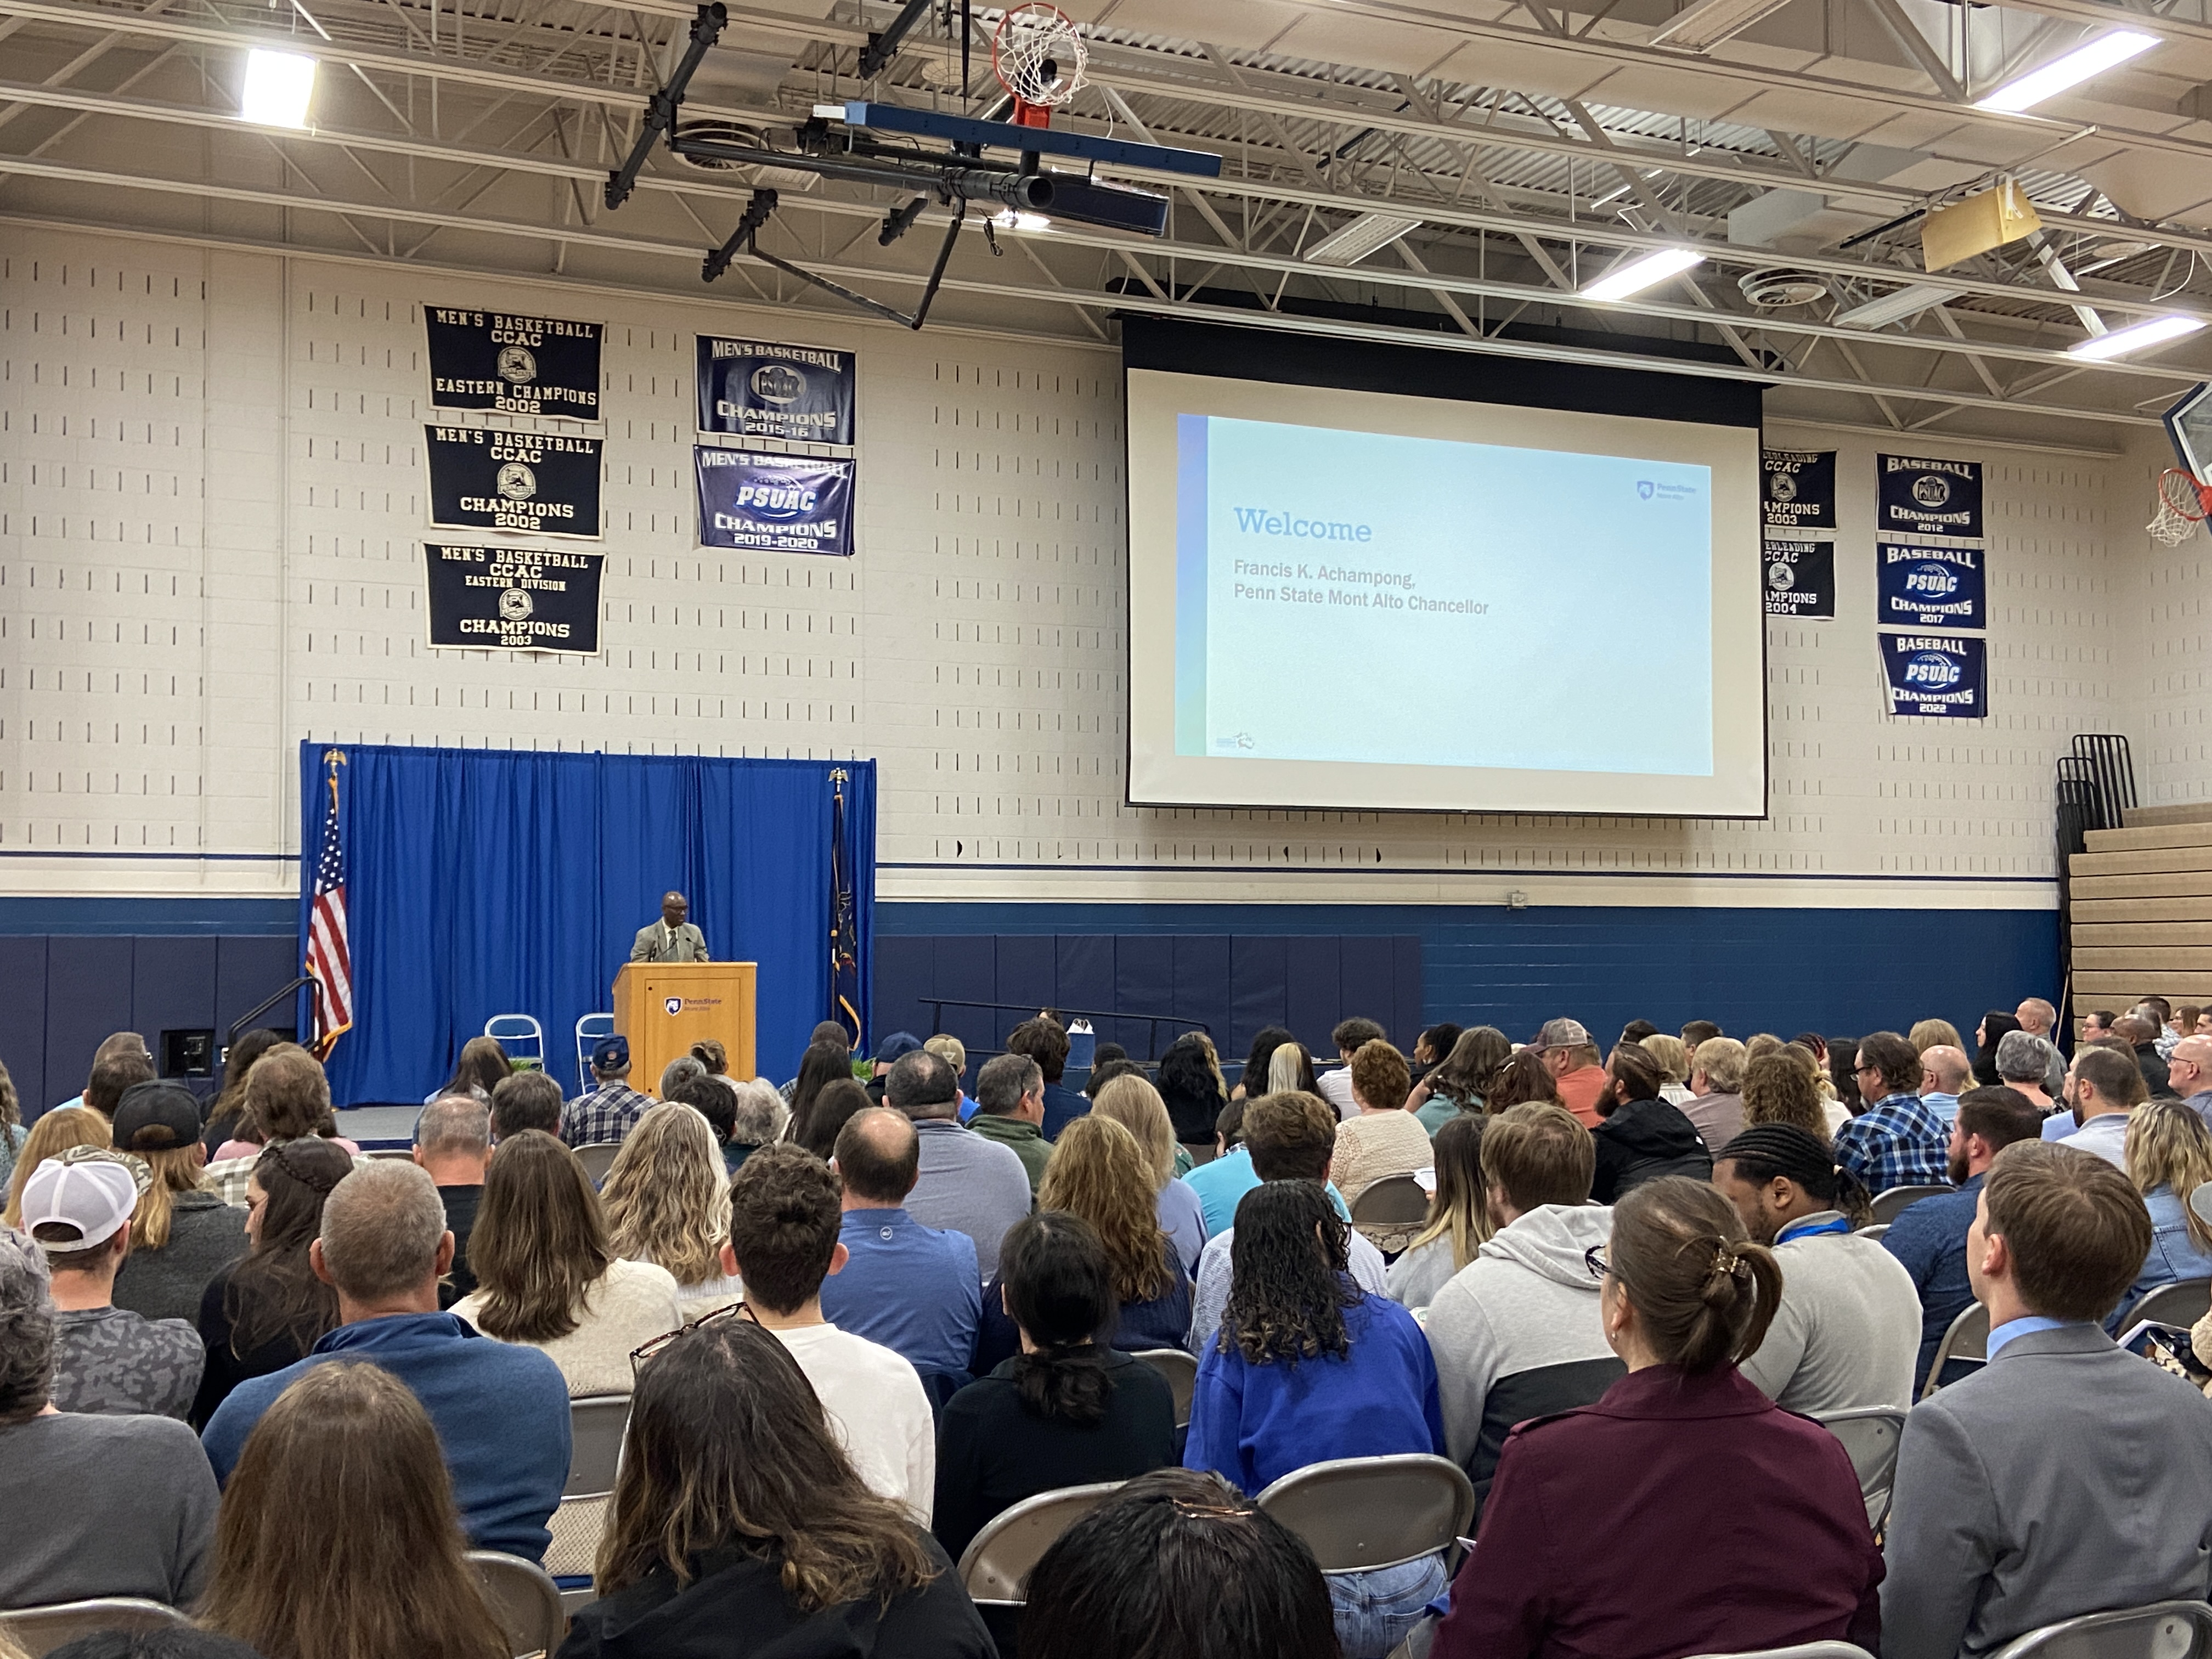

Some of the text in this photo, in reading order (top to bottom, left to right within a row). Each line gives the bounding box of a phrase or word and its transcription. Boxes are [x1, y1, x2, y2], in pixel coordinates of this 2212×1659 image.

[436, 310, 593, 338] MEN'S BASKETBALL
[491, 330, 542, 347] CCAC
[712, 341, 842, 373] MEN'S BASKETBALL
[436, 378, 596, 405] EASTERN CHAMPIONS
[495, 396, 540, 414] 2002
[717, 399, 836, 428] CHAMPIONS
[746, 422, 808, 436] 2015-16
[436, 428, 594, 454] MEN'S BASKETBALL
[490, 447, 541, 463] CCAC
[703, 452, 749, 467] MEN'S
[1763, 451, 1818, 463] EERLEADING
[1765, 461, 1801, 473] CCAC
[1887, 457, 1973, 480] BASEBALL
[736, 487, 816, 511] PSUAC
[1918, 483, 1945, 500] PSUAC
[460, 497, 574, 518] CHAMPIONS
[1764, 501, 1820, 515] AMPIONS
[1890, 505, 1970, 524] CHAMPIONS
[495, 514, 540, 530] 2002
[715, 513, 836, 539] CHAMPIONS
[1234, 507, 1372, 542] Welcome
[1767, 513, 1797, 525] 2003
[1918, 523, 1943, 532] 2012
[734, 533, 818, 549] 2019-2020
[1765, 541, 1815, 552] ERLEADING
[441, 547, 588, 568] MEN'S BASKETBALL
[1765, 551, 1798, 563] CCAC
[1887, 547, 1976, 569] BASEBALL
[489, 563, 542, 579] CCAC
[1234, 560, 1416, 590] Francis K. Achampong,
[465, 575, 566, 591] EASTERN DIVISION
[1906, 574, 1957, 592] PSUAC
[1234, 584, 1489, 615] Penn State Mont Alto Chancellor
[1765, 602, 1797, 614] 2004
[1891, 596, 1972, 615] CHAMPIONS
[1920, 614, 1944, 623] 2017
[460, 619, 569, 637] CHAMPIONS
[501, 635, 532, 645] 2003
[1897, 637, 1967, 656] BASEBALL
[1906, 664, 1960, 682] PSUAC
[1892, 687, 1973, 704] CHAMPIONS
[1919, 703, 1946, 713] 2022
